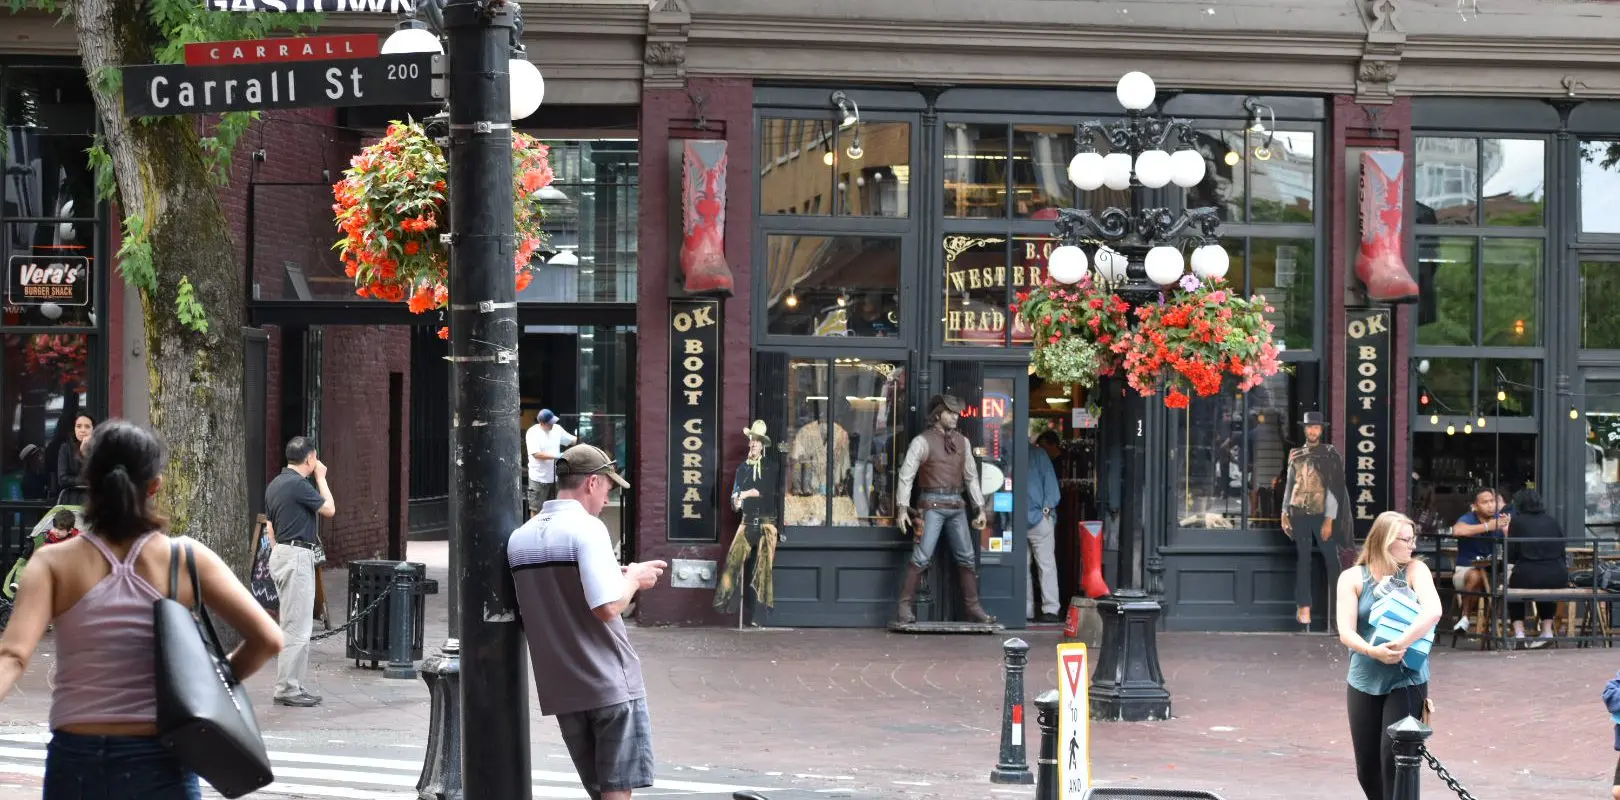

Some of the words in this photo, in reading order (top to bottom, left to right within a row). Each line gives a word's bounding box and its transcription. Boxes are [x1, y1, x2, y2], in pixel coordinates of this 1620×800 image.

[210, 41, 353, 60] CARRALL
[150, 70, 296, 108] Carrall
[325, 66, 364, 100] St
[387, 63, 419, 80] 200
[20, 263, 78, 286] Vera's
[950, 266, 1050, 292] WESTER
[24, 286, 50, 296] BURGER
[51, 286, 73, 296] SHACK
[673, 305, 716, 332] OK
[949, 310, 1006, 332] HEAD
[1348, 314, 1388, 339] OK
[683, 339, 705, 406] BOOT
[1357, 345, 1377, 410] BOOT
[682, 418, 704, 519] CORRAL
[1357, 424, 1376, 520] CORRAL
[1068, 778, 1082, 794] AND
